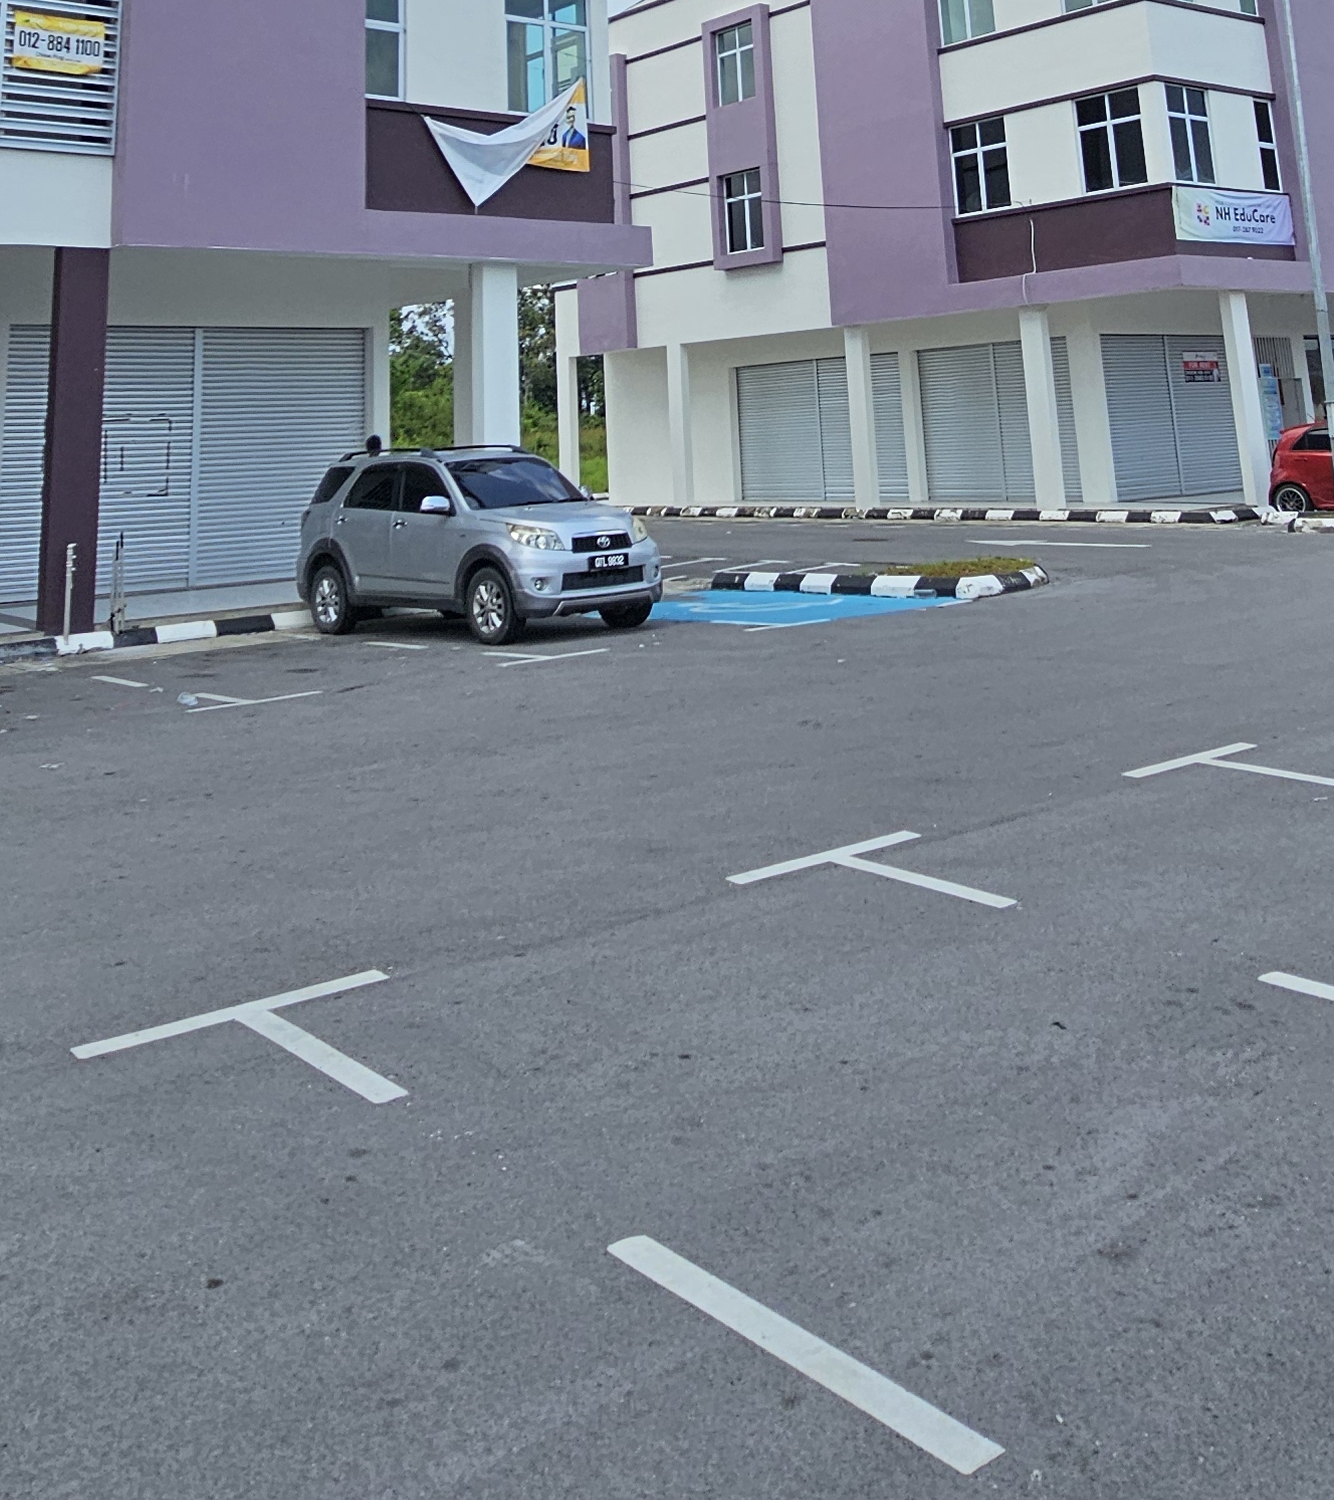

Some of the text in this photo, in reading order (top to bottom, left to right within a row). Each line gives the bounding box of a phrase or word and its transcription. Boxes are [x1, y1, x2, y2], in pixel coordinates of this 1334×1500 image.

[19, 30, 101, 57] 012-884 1100
[1215, 206, 1276, 224] NH EduCare
